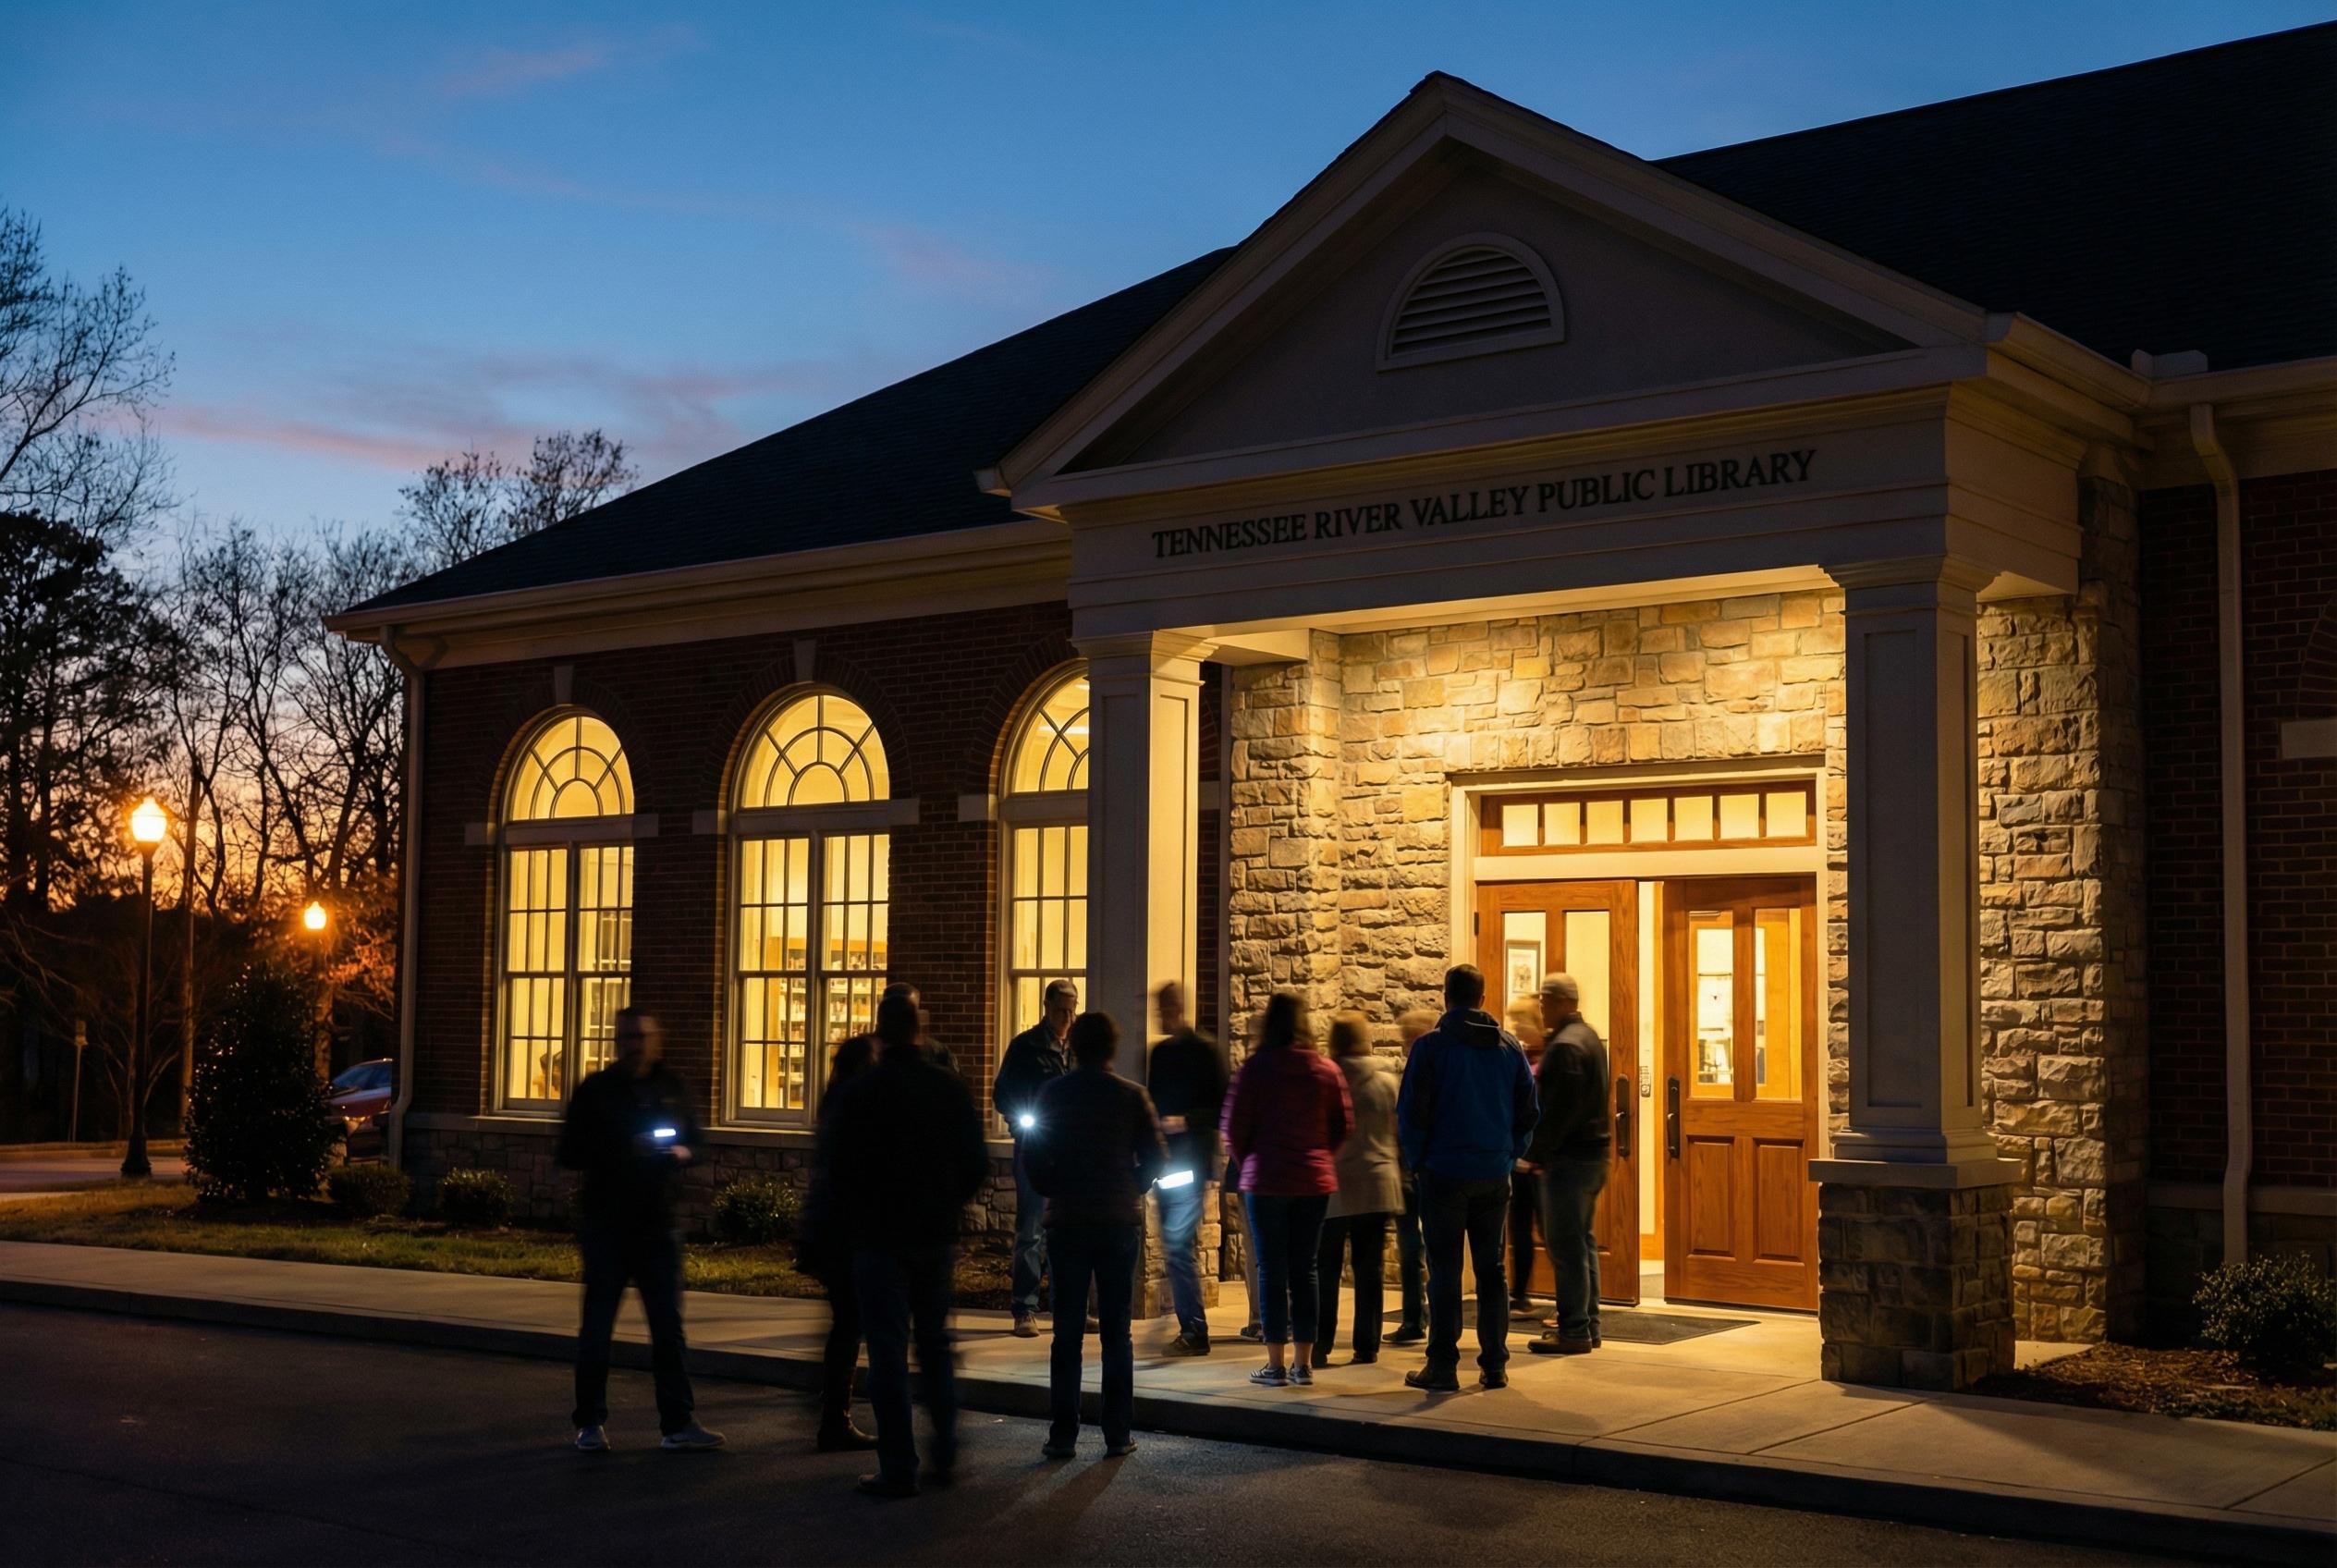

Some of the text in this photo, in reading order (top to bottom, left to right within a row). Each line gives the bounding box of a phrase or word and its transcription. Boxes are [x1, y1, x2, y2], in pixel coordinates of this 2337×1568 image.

[1152, 449, 1817, 558] TENNESSEE RIVER VALLEY PUBLIC LIBRARY
